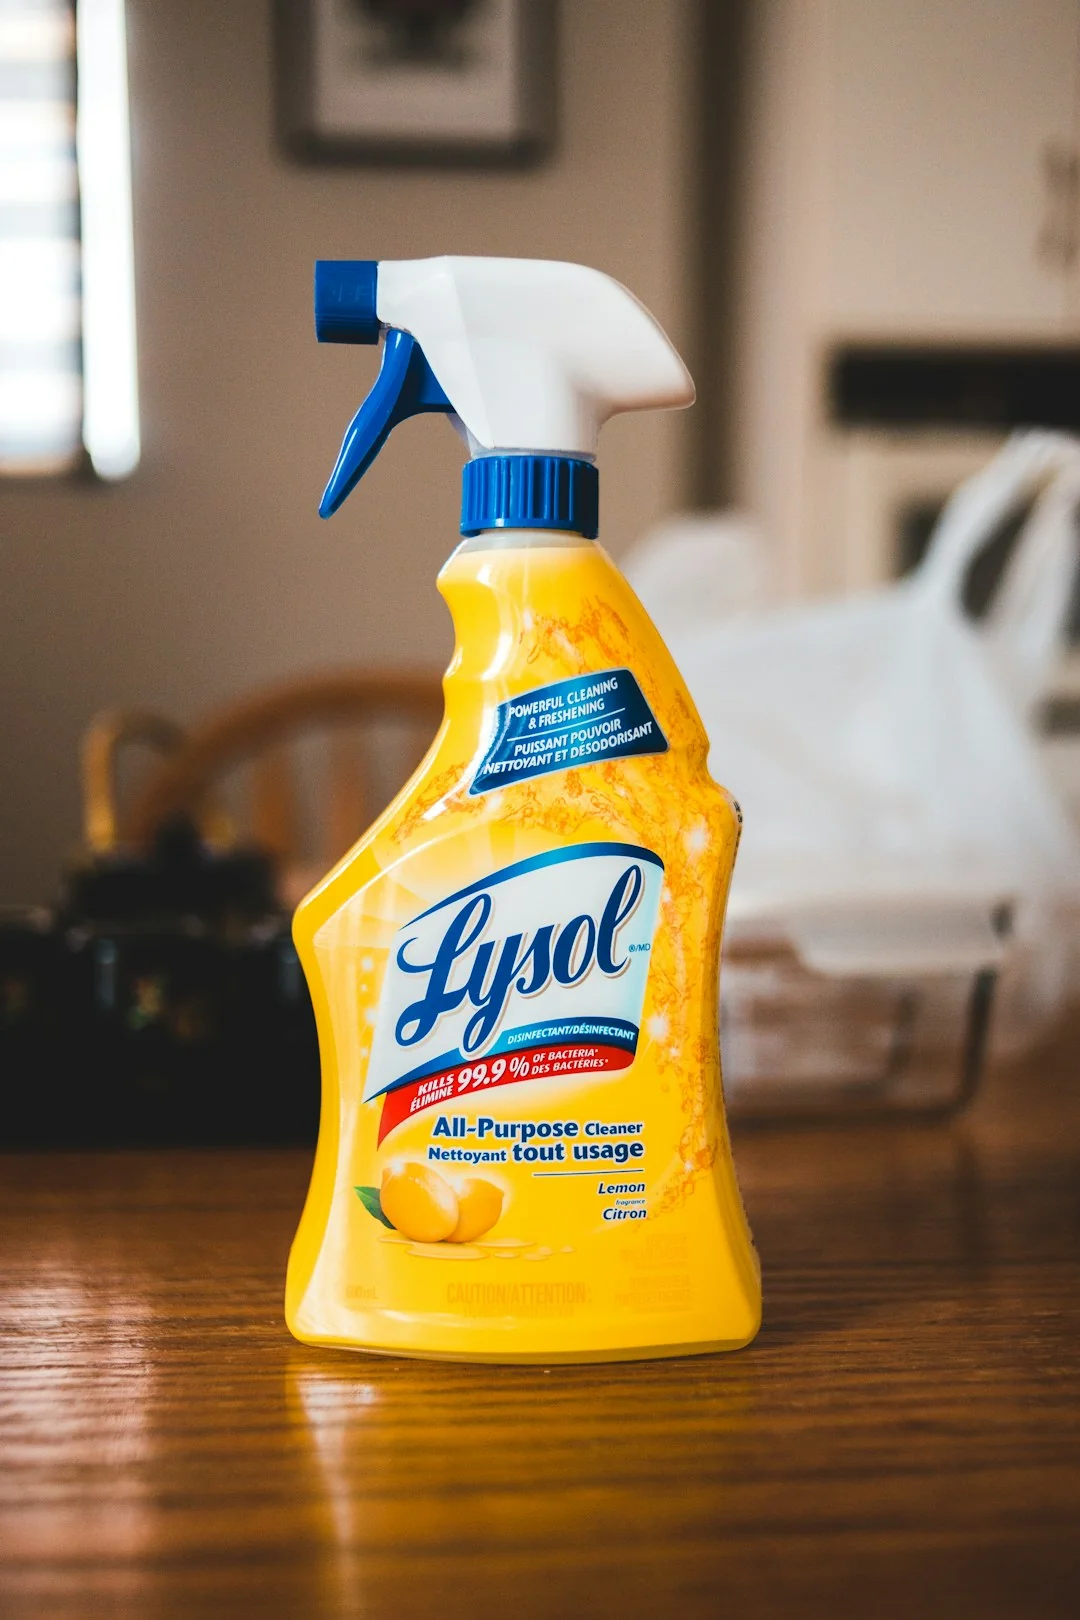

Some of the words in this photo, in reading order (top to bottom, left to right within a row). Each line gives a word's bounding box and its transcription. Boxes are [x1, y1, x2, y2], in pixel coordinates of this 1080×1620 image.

[508, 696, 564, 719] POWERFUL
[567, 677, 618, 704] CLEANING
[528, 718, 537, 730] &
[539, 698, 605, 728] FRESHENING
[483, 753, 552, 775] NETTOYANT
[554, 748, 568, 762] ET
[570, 721, 653, 759] DÉSODORISANT
[514, 735, 568, 756] PUISSANT
[571, 718, 622, 746] POUVOIR
[395, 864, 643, 1053] Lysol
[507, 1022, 636, 1045] DISINFECTANT/DÉSINFECTANT
[531, 1064, 550, 1075] DES
[533, 1052, 546, 1063] OF
[418, 1074, 454, 1096] KILLS
[410, 1086, 454, 1113] ÉLIMINE
[432, 1116, 578, 1143] All-Purpose
[585, 1122, 643, 1136] Cleaner
[428, 1147, 507, 1165] Nettoyant
[513, 1142, 565, 1162] tout
[573, 1142, 644, 1163] usage
[598, 1182, 645, 1194] Lemon
[603, 1208, 647, 1220] Citron
